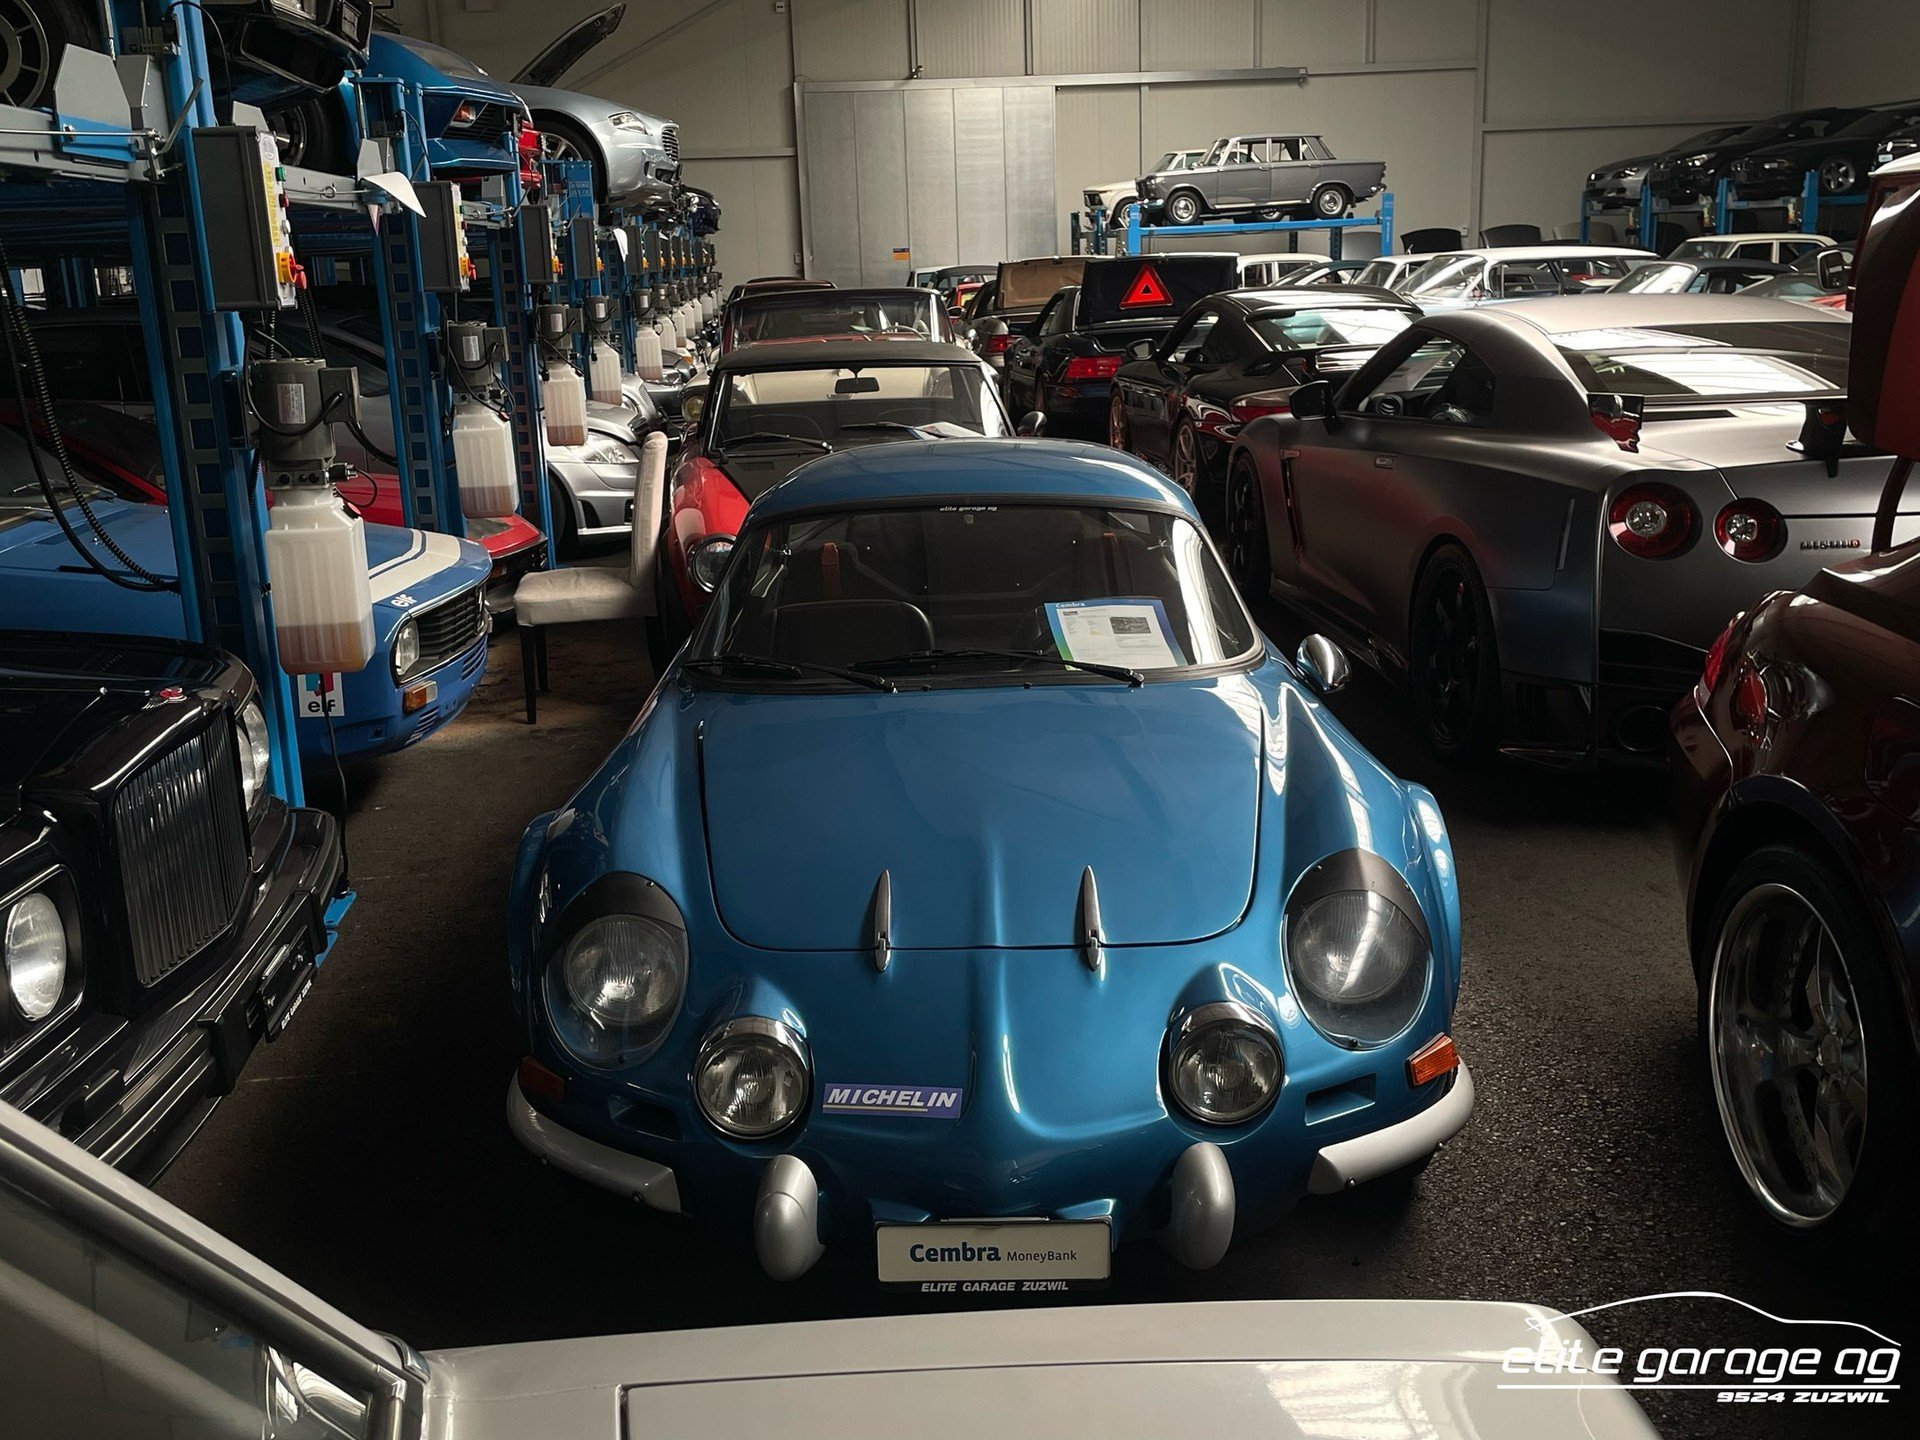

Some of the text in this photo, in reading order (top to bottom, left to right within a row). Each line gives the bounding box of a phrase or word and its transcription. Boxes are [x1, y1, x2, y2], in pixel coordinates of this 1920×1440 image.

[308, 699, 336, 713] ef
[827, 1088, 958, 1108] MICHELIN
[909, 1242, 1078, 1264] Cembra MoneyBank
[921, 1281, 1070, 1293] ELITE GARAGE ZUZWIL
